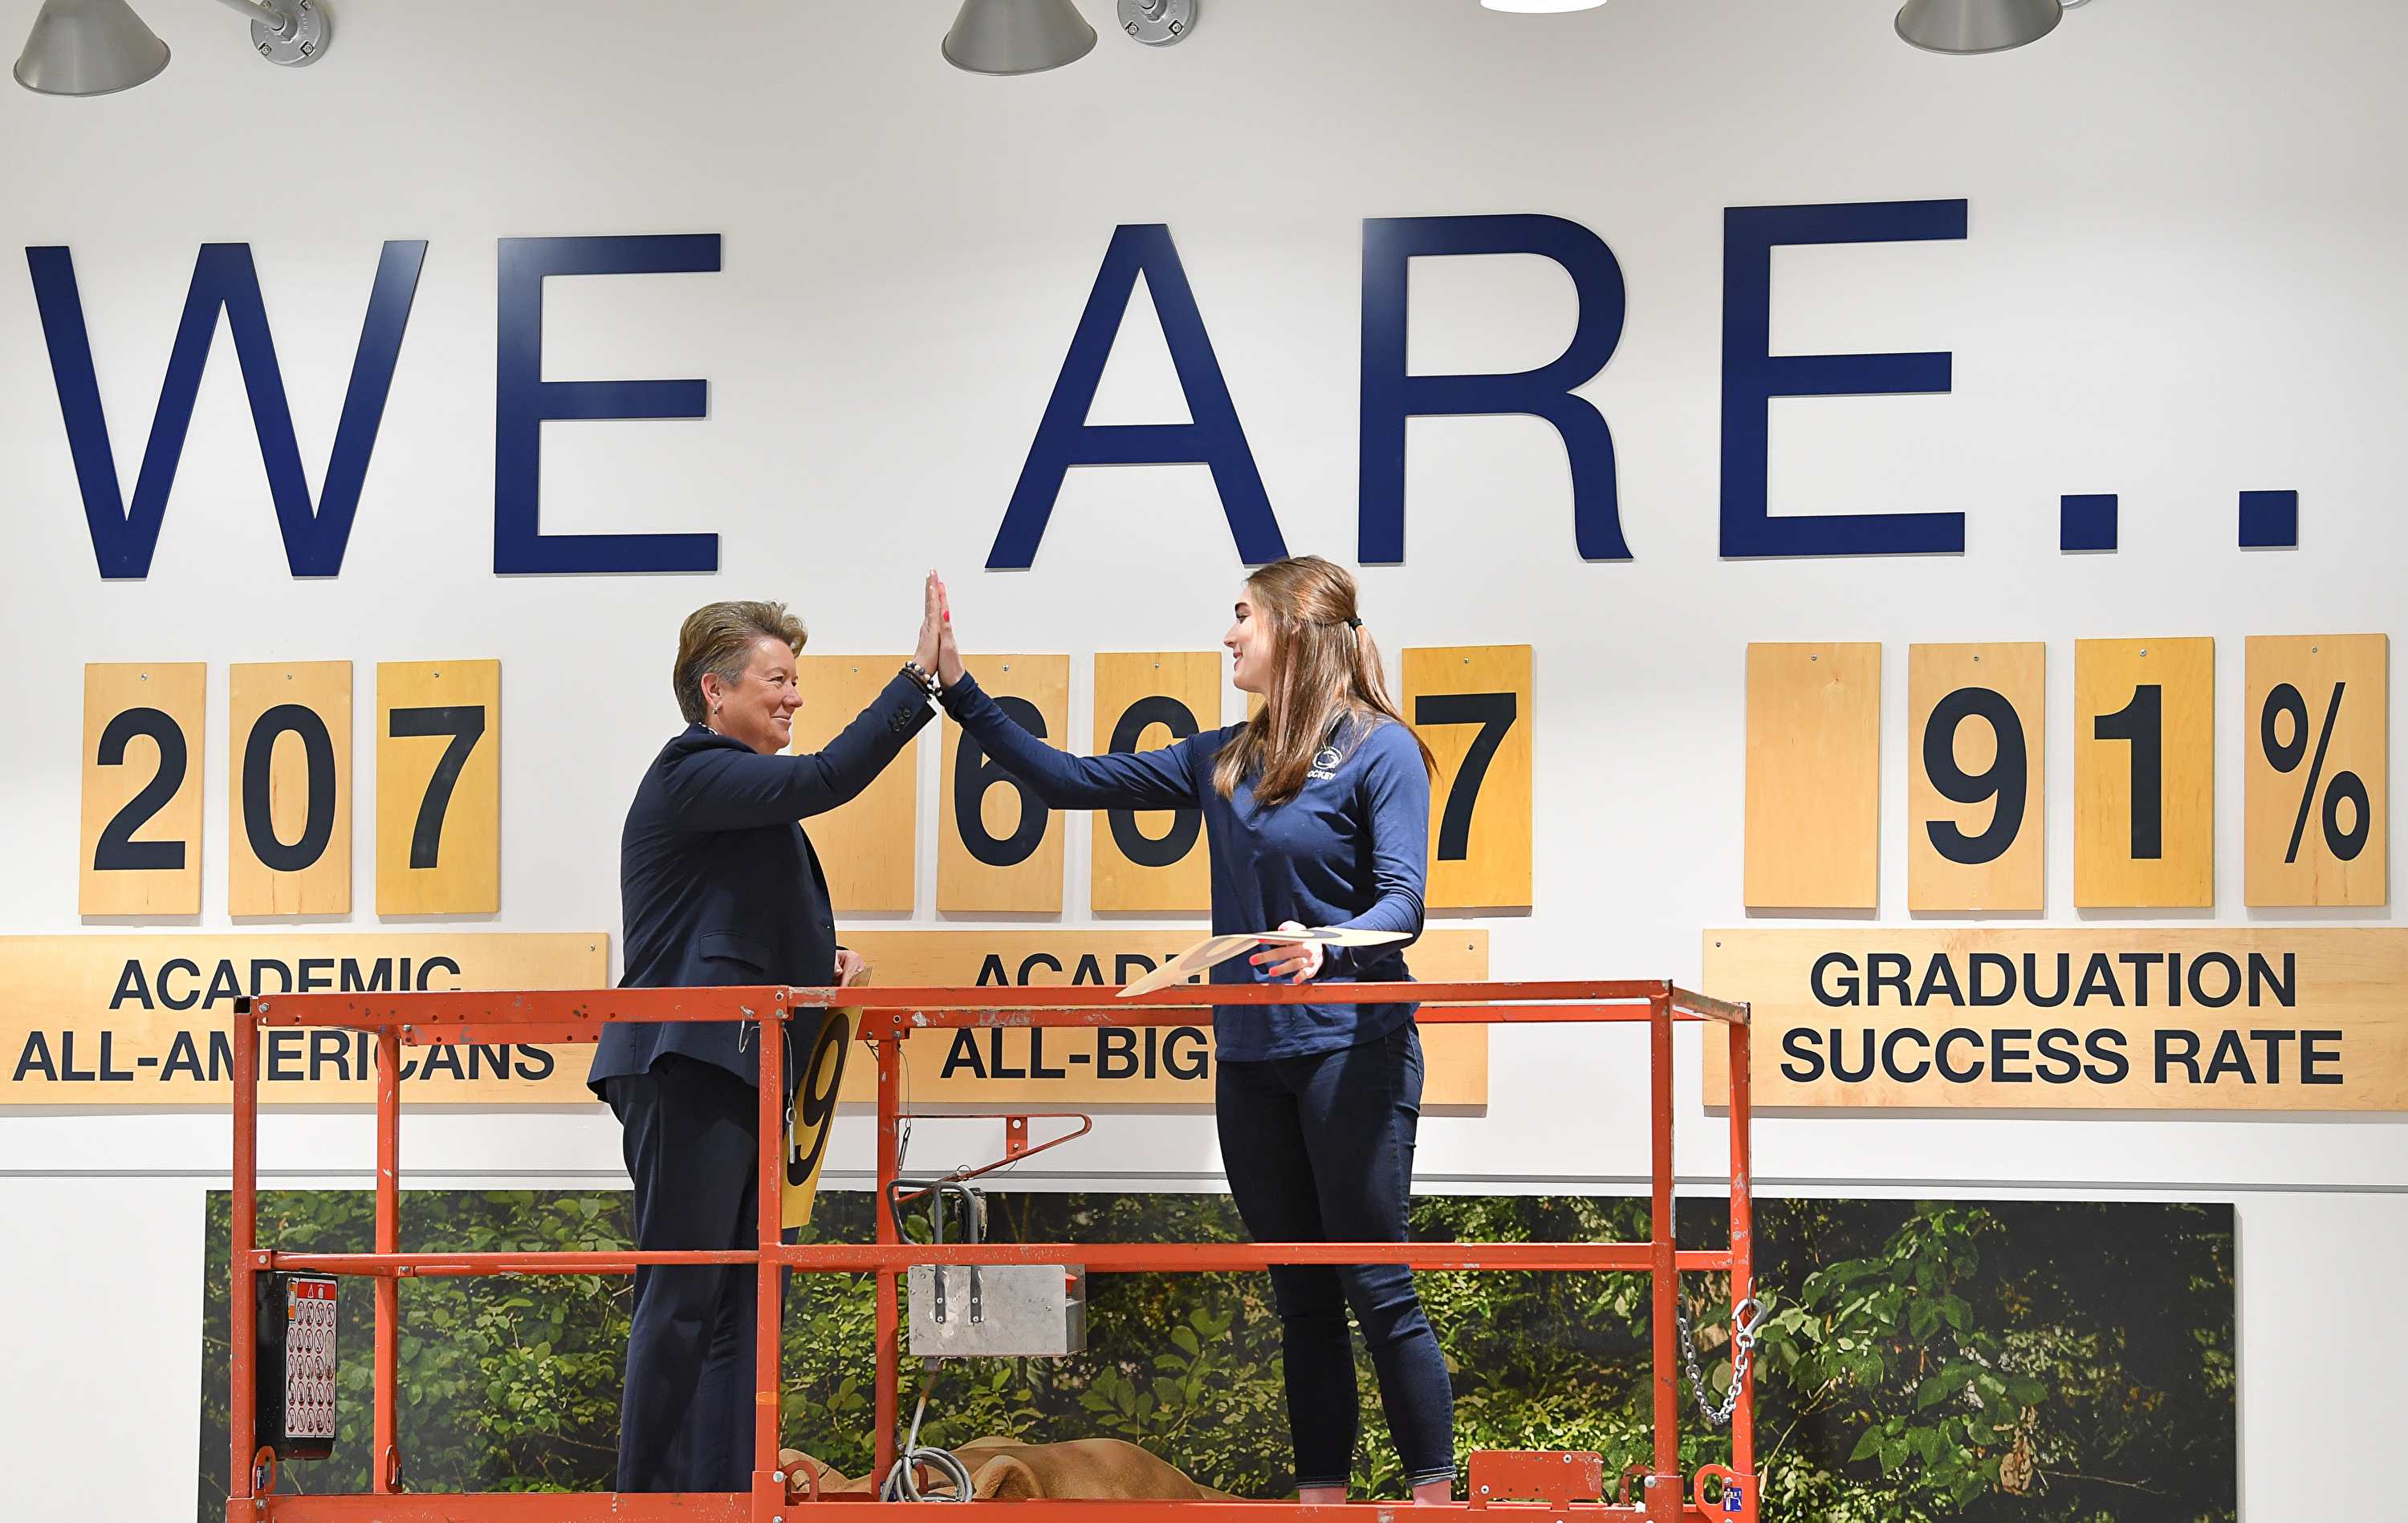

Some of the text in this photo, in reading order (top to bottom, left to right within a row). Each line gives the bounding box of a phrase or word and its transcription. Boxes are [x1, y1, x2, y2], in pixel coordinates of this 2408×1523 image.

[25, 234, 721, 579] WE
[94, 705, 485, 871] 207
[1307, 770, 1336, 780] OCKEY
[1923, 682, 2369, 864] 91%
[109, 956, 461, 1010] ACADEMIC
[975, 953, 1210, 986] ACAD
[1811, 952, 2295, 1007] GRADUATION
[941, 1026, 1209, 1080] ALL-BIG
[1781, 1028, 2343, 1084] SUCCESS RATE
